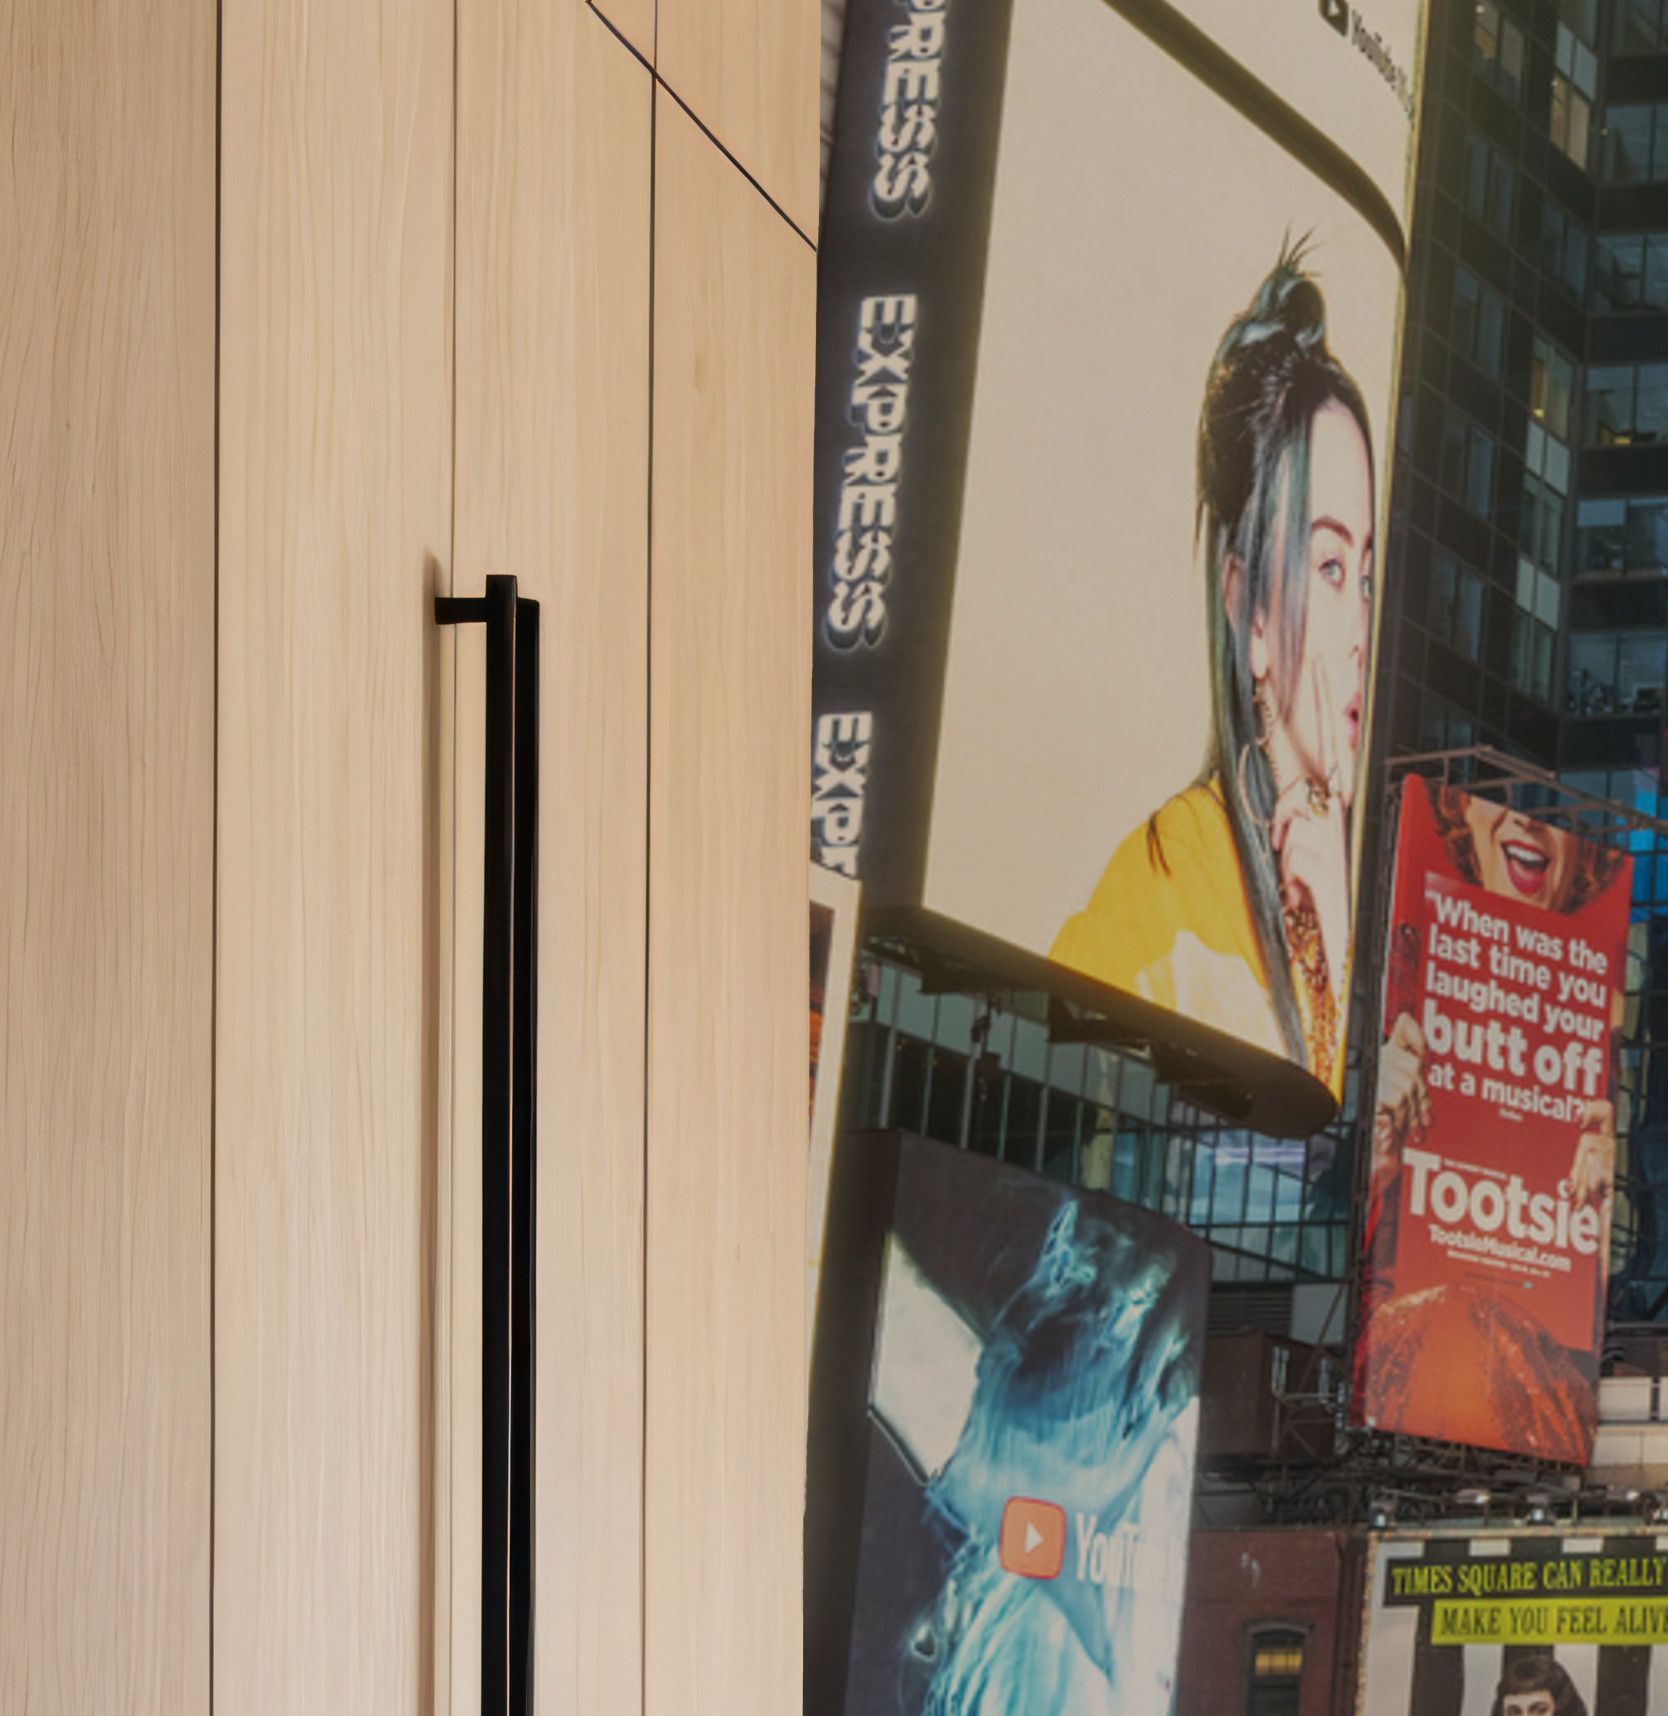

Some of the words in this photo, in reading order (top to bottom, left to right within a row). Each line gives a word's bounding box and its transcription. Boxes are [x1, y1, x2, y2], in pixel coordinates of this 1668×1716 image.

[828, 295, 917, 650] EXPRESS
[1429, 923, 1481, 970] last
[1490, 945, 1550, 990] time
[1559, 967, 1606, 1009] you
[1516, 923, 1563, 961] was
[1570, 938, 1608, 974] the
[1426, 961, 1539, 1025] laughed
[1545, 1001, 1605, 1043] your
[1422, 998, 1528, 1077] butt
[1534, 1039, 1604, 1096] off
[1428, 1061, 1456, 1090] at
[1460, 1072, 1476, 1096] a
[1402, 1146, 1600, 1255] Tootsie
[1427, 1222, 1572, 1273] TootsieMusical.com
[1392, 1563, 1452, 1598] TIMES
[1457, 1561, 1538, 1597] SQUARE
[1543, 1558, 1583, 1592] CAN
[1589, 1555, 1666, 1589] REALLY
[1441, 1604, 1502, 1638] MAKE
[1508, 1604, 1550, 1637] YOU
[1557, 1604, 1609, 1636] FEEL
